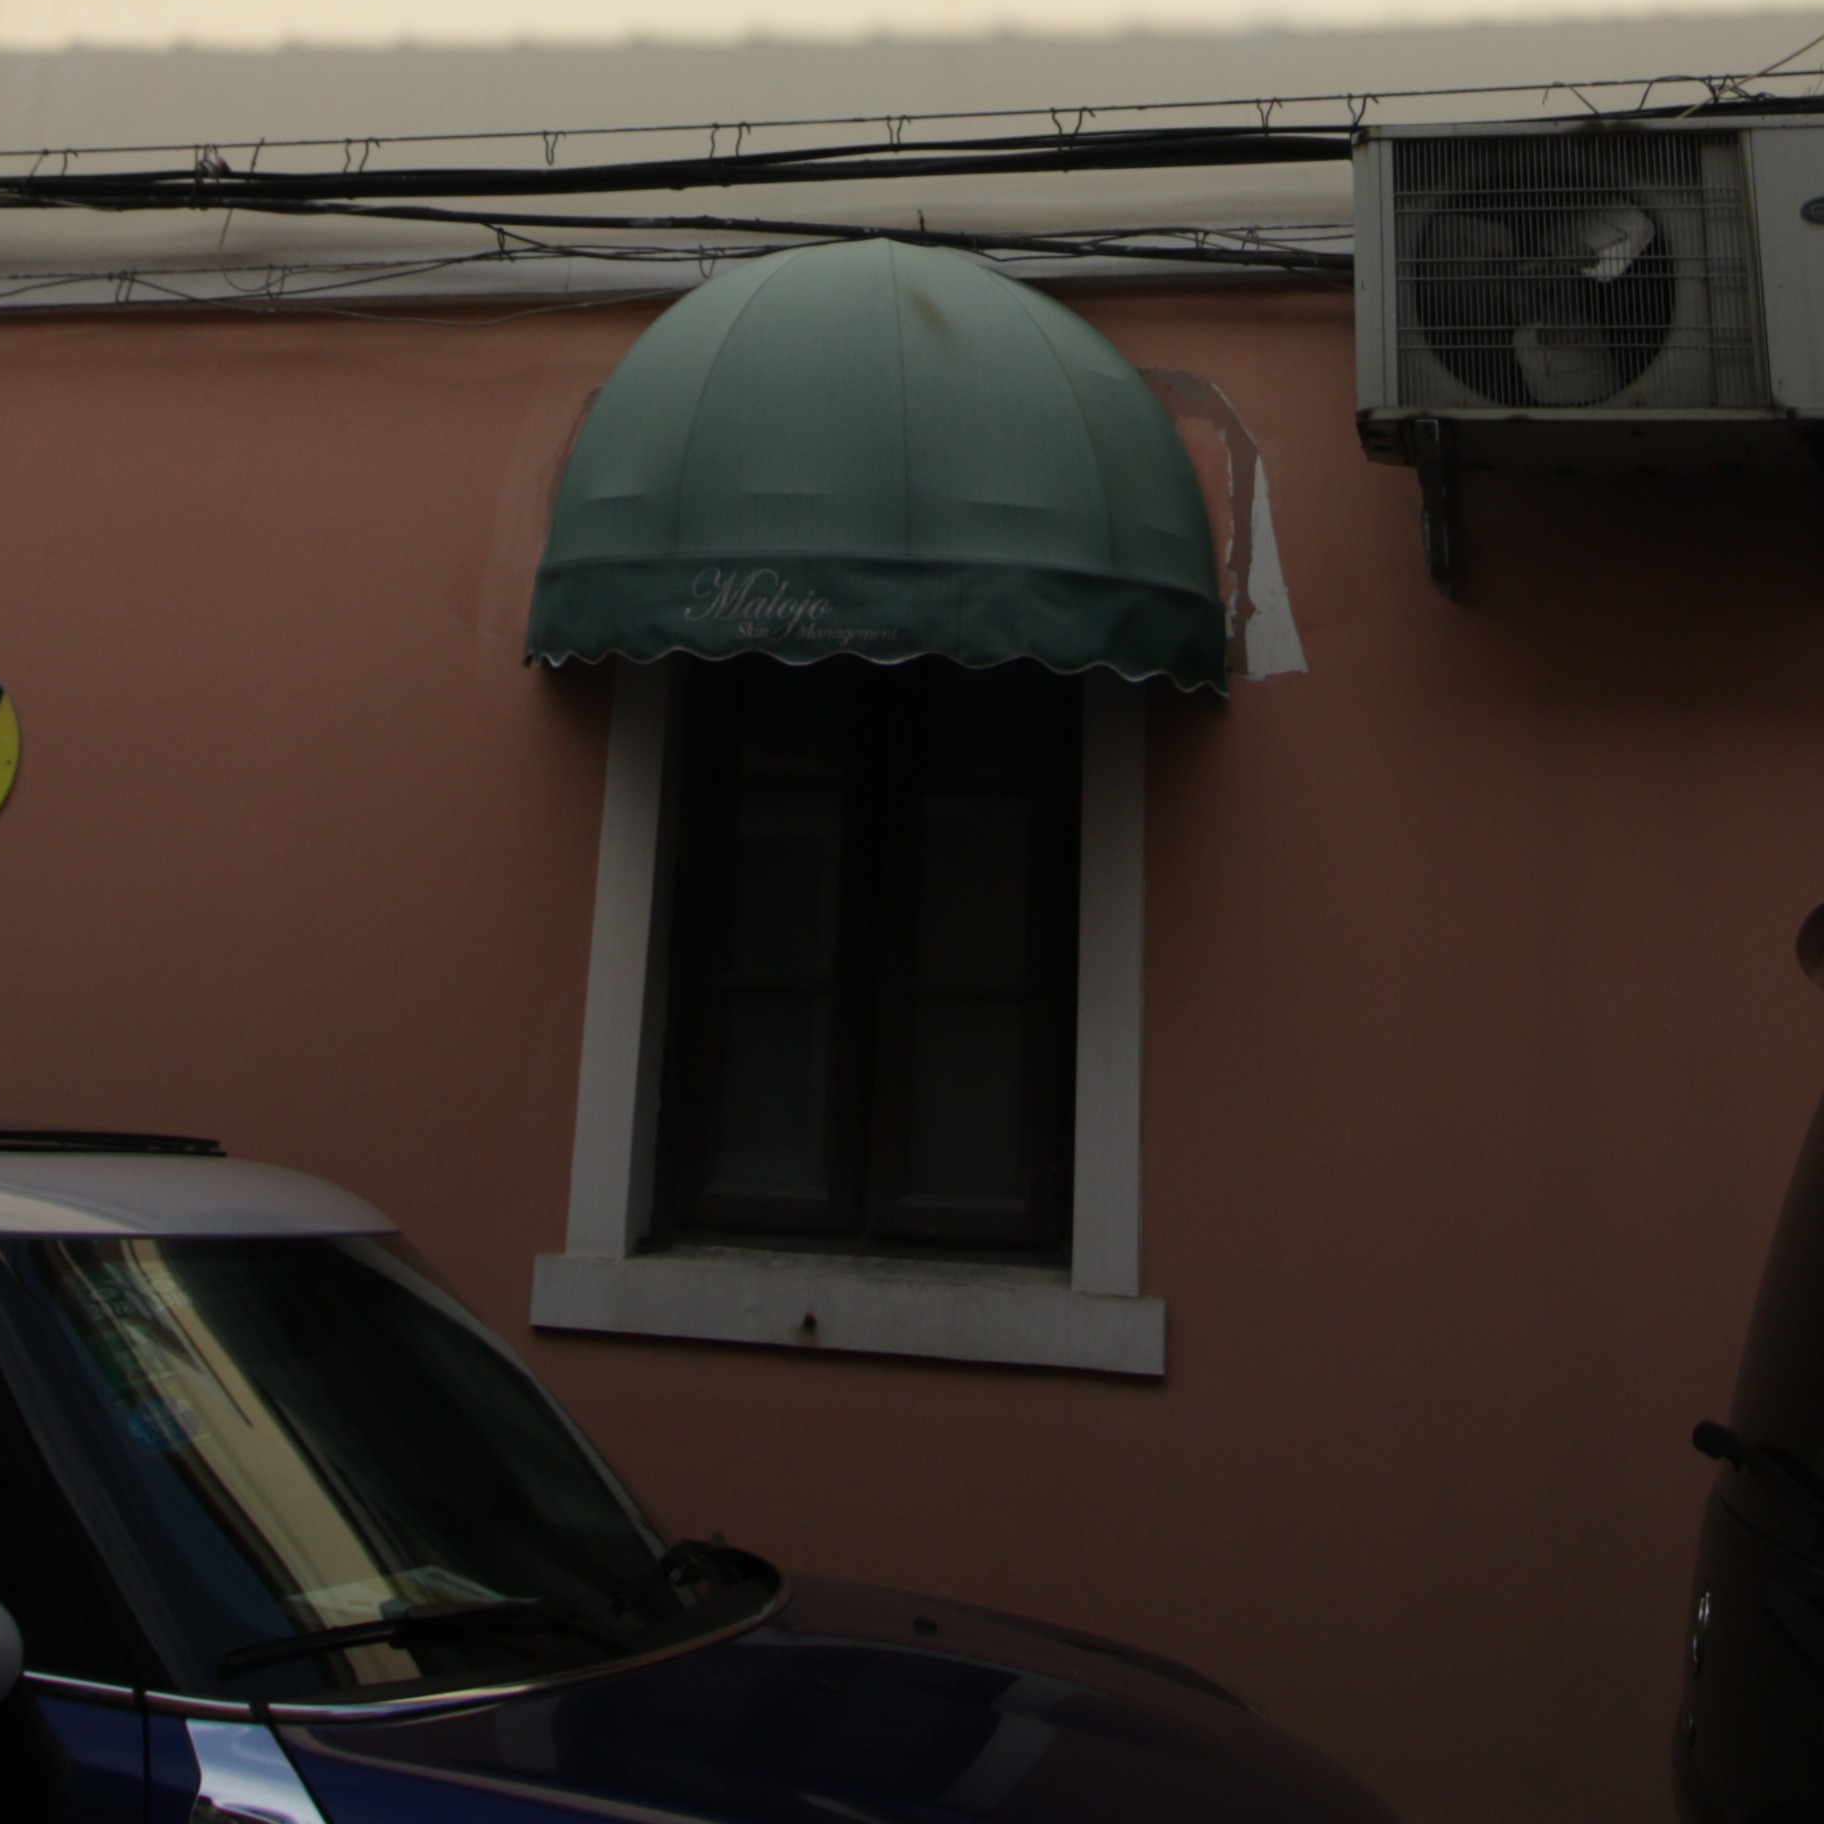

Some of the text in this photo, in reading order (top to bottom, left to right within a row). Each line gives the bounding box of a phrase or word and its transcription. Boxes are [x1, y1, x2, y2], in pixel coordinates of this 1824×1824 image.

[684, 566, 832, 641] Malojo
[736, 622, 898, 646] Skin Management
